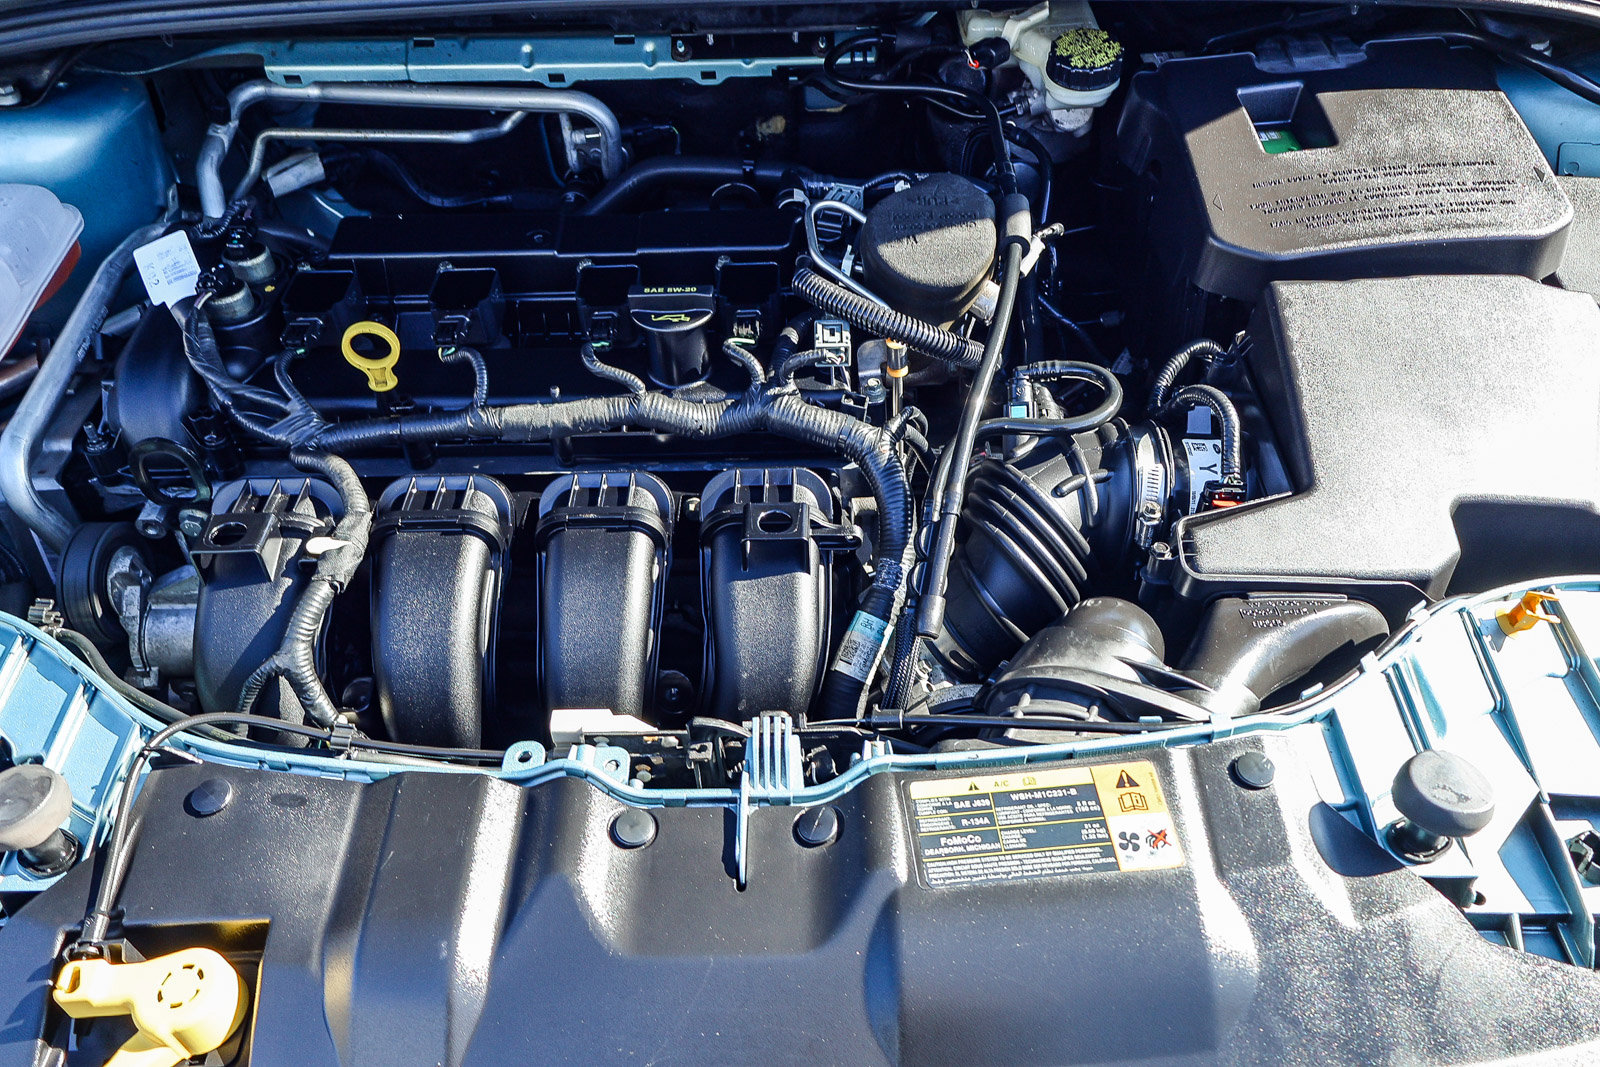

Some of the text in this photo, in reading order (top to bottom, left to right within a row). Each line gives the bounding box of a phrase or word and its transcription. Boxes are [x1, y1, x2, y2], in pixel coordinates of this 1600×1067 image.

[1199, 463, 1218, 475] Y
[953, 801, 972, 809] SAE
[961, 816, 991, 826] R-134A
[940, 834, 982, 846] FoMoCo
[966, 842, 1002, 851] MICHIGAN
